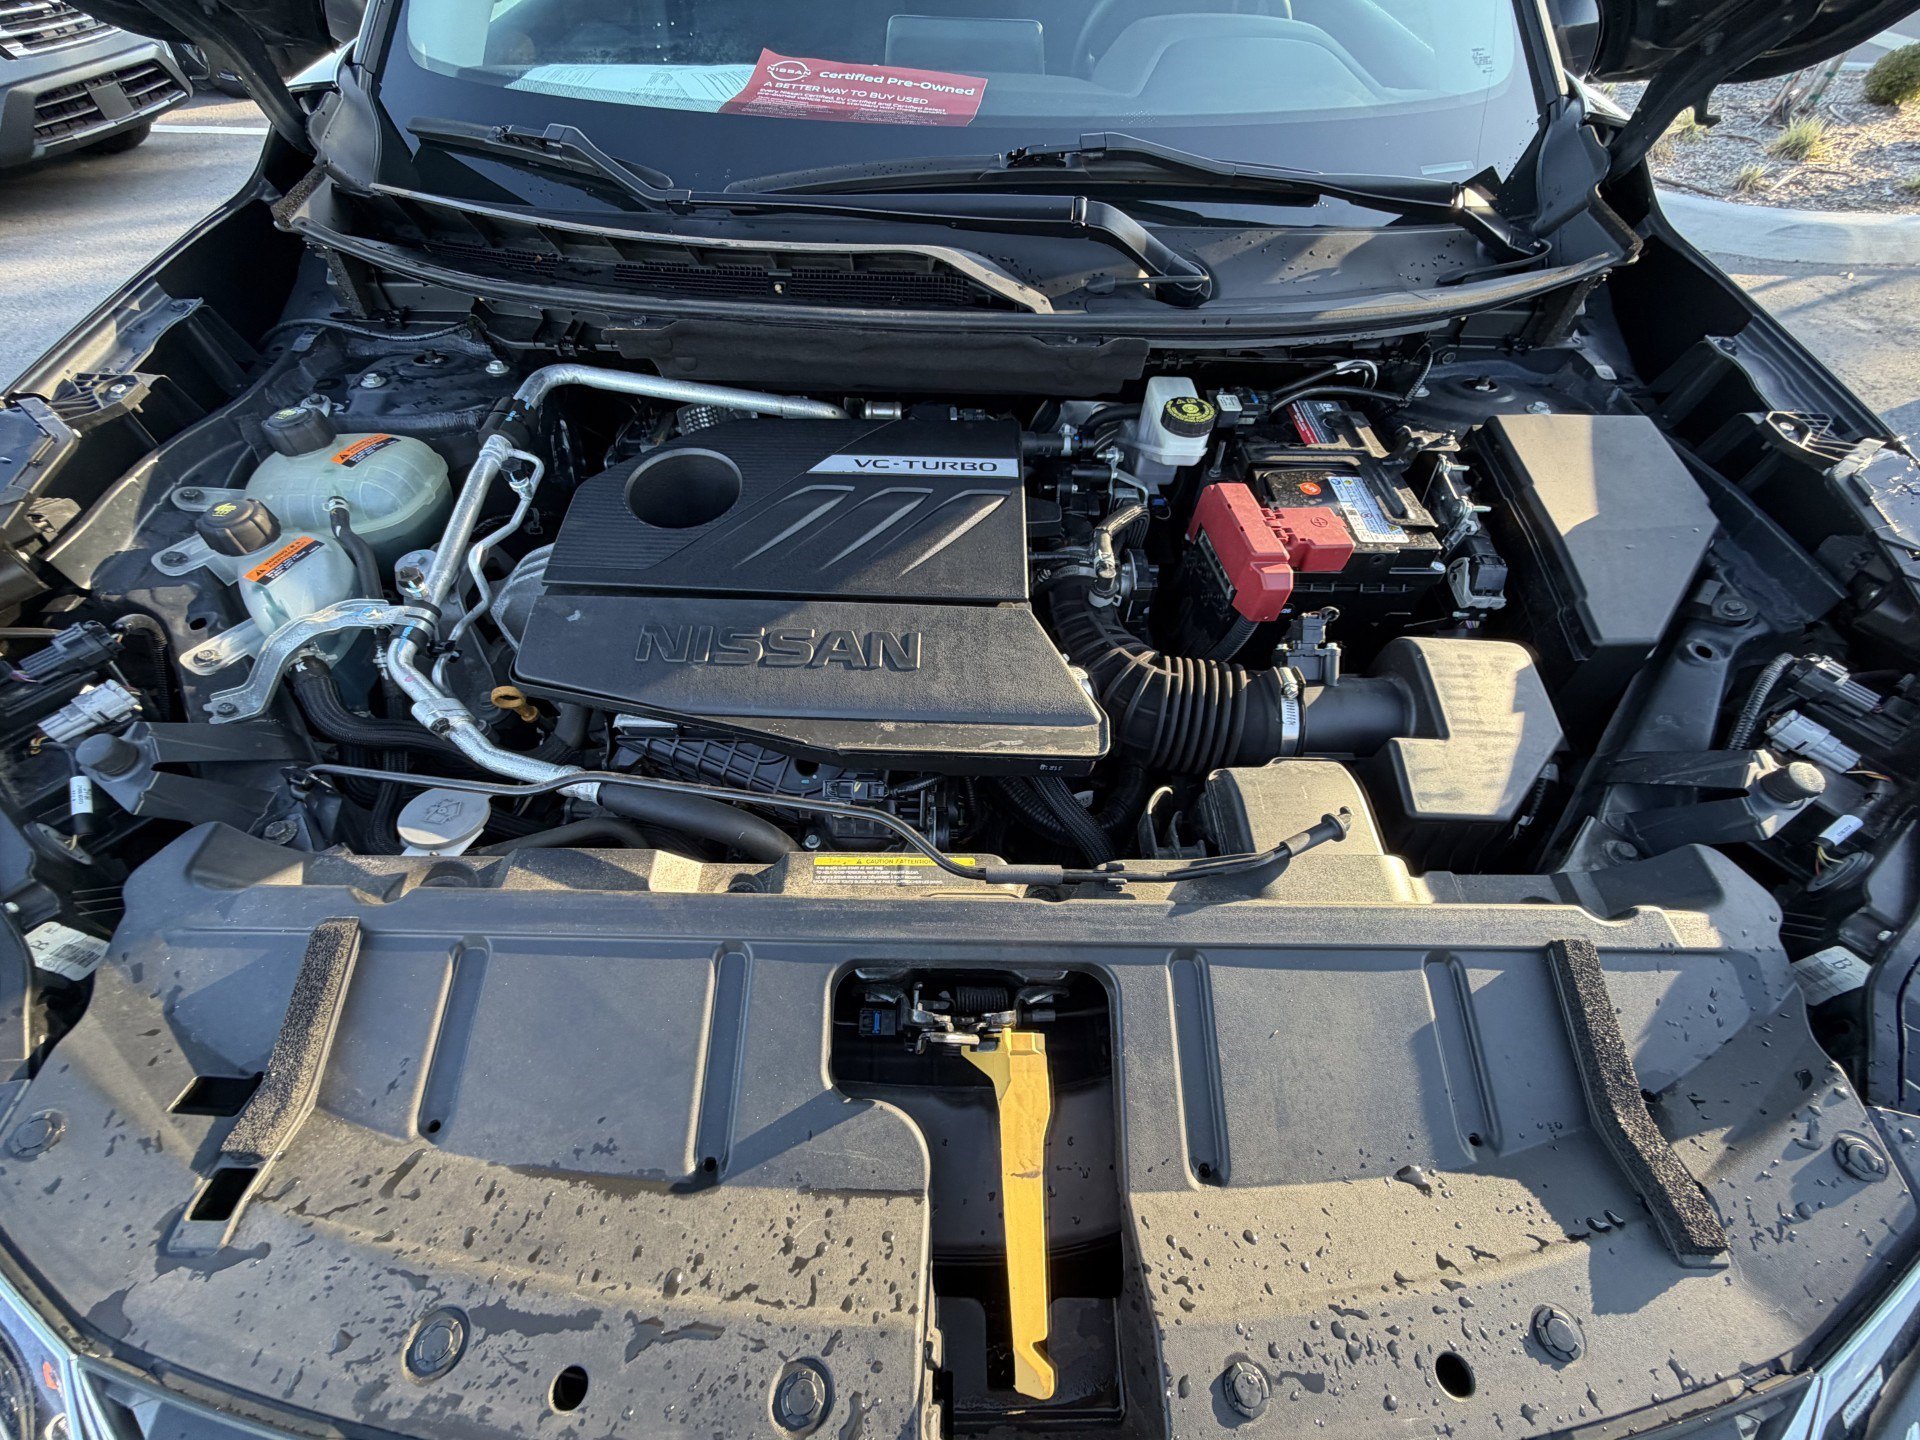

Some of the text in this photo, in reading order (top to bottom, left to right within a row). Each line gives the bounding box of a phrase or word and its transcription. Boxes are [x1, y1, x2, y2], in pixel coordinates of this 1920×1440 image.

[767, 65, 812, 76] NISSAN
[819, 71, 976, 96] Certified Pre-Owned
[775, 82, 821, 92] BETTER
[823, 86, 849, 95] WAY
[851, 89, 867, 97] TO
[869, 91, 895, 101] BUY
[896, 95, 929, 105] USED
[853, 458, 998, 472] VC-TURBO
[634, 623, 922, 670] NISSAN
[1830, 957, 1853, 970] B
